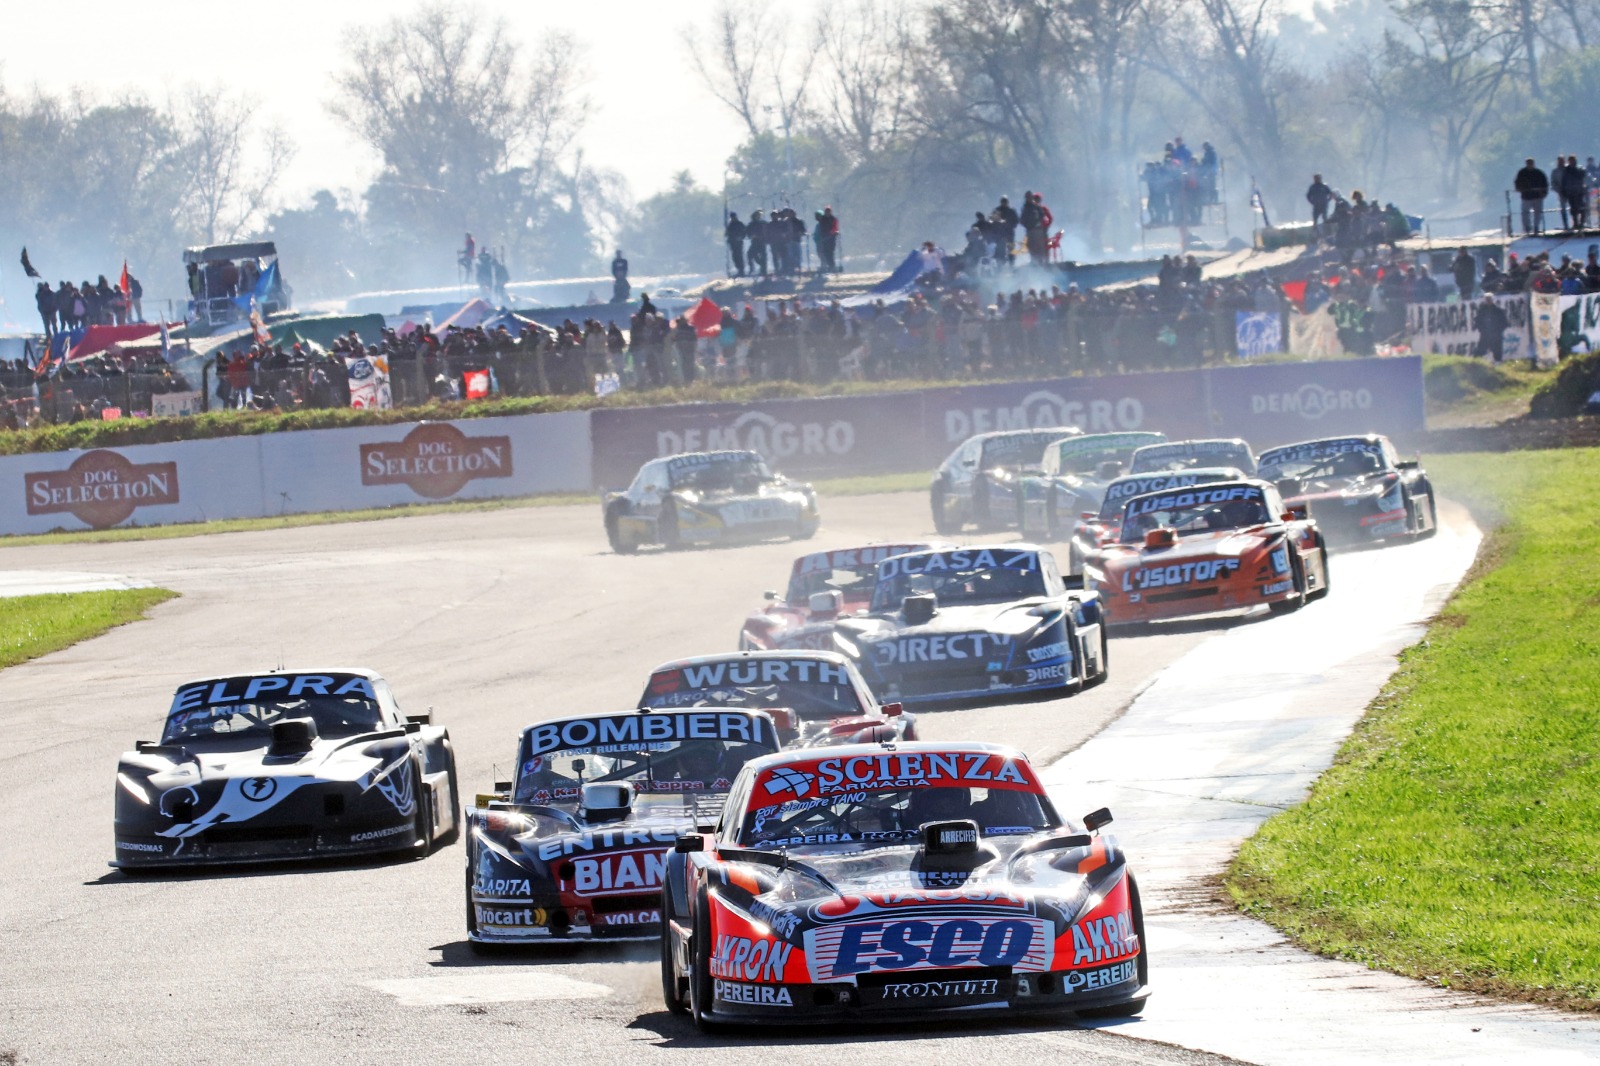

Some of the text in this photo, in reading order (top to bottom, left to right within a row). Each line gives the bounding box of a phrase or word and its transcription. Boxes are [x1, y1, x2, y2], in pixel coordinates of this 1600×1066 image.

[1252, 387, 1372, 416] DEMAGRO
[945, 396, 1144, 441] DEMAGRO
[418, 441, 453, 456] DOG
[657, 418, 855, 457] DEMAGRO
[83, 469, 118, 485] DOG
[366, 445, 503, 477] SELECTION
[32, 472, 169, 506] SELECTION
[1108, 476, 1197, 500] ROYCAN
[875, 633, 1011, 667] DIRECTV
[684, 660, 849, 689] WÜRTH
[171, 675, 376, 713] ELPRA
[530, 713, 763, 755] BOMBIERI
[559, 747, 593, 758] TODO
[817, 752, 1030, 788] SCIENZA
[820, 778, 932, 795] FARMACIA
[755, 792, 868, 819] Por siempre TANO
[940, 829, 976, 844] ARRECIFES
[475, 905, 534, 925] Brocart
[831, 919, 1035, 977] ESCO
[1071, 909, 1139, 966] AKRON
[708, 933, 794, 982] AKRON
[713, 979, 794, 1005] PEREIRA
[1063, 959, 1138, 995] PEREIRA
